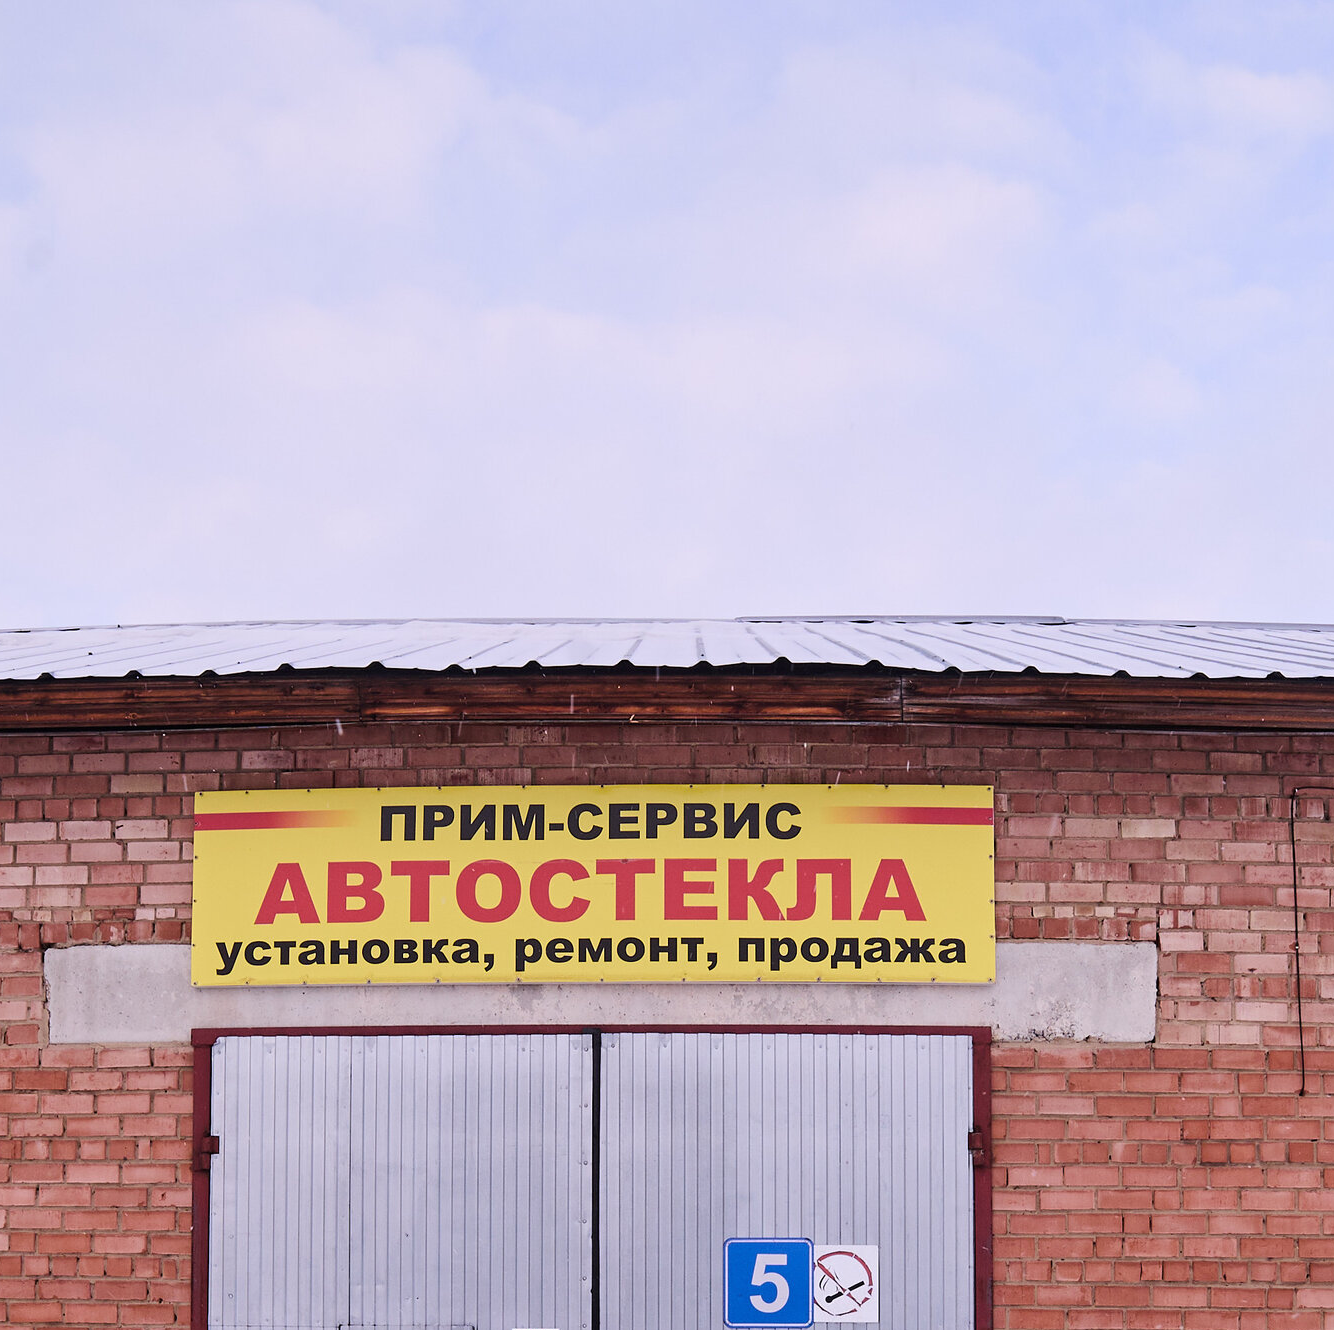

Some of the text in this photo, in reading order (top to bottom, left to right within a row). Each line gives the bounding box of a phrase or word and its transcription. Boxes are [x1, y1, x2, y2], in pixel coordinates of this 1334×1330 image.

[380, 802, 802, 842] ПРИМ-СЕРВИС
[253, 858, 927, 925] АВТОСТЕКЛА
[215, 936, 967, 976] установка, ремонт, продажа
[749, 1253, 790, 1314] 5
